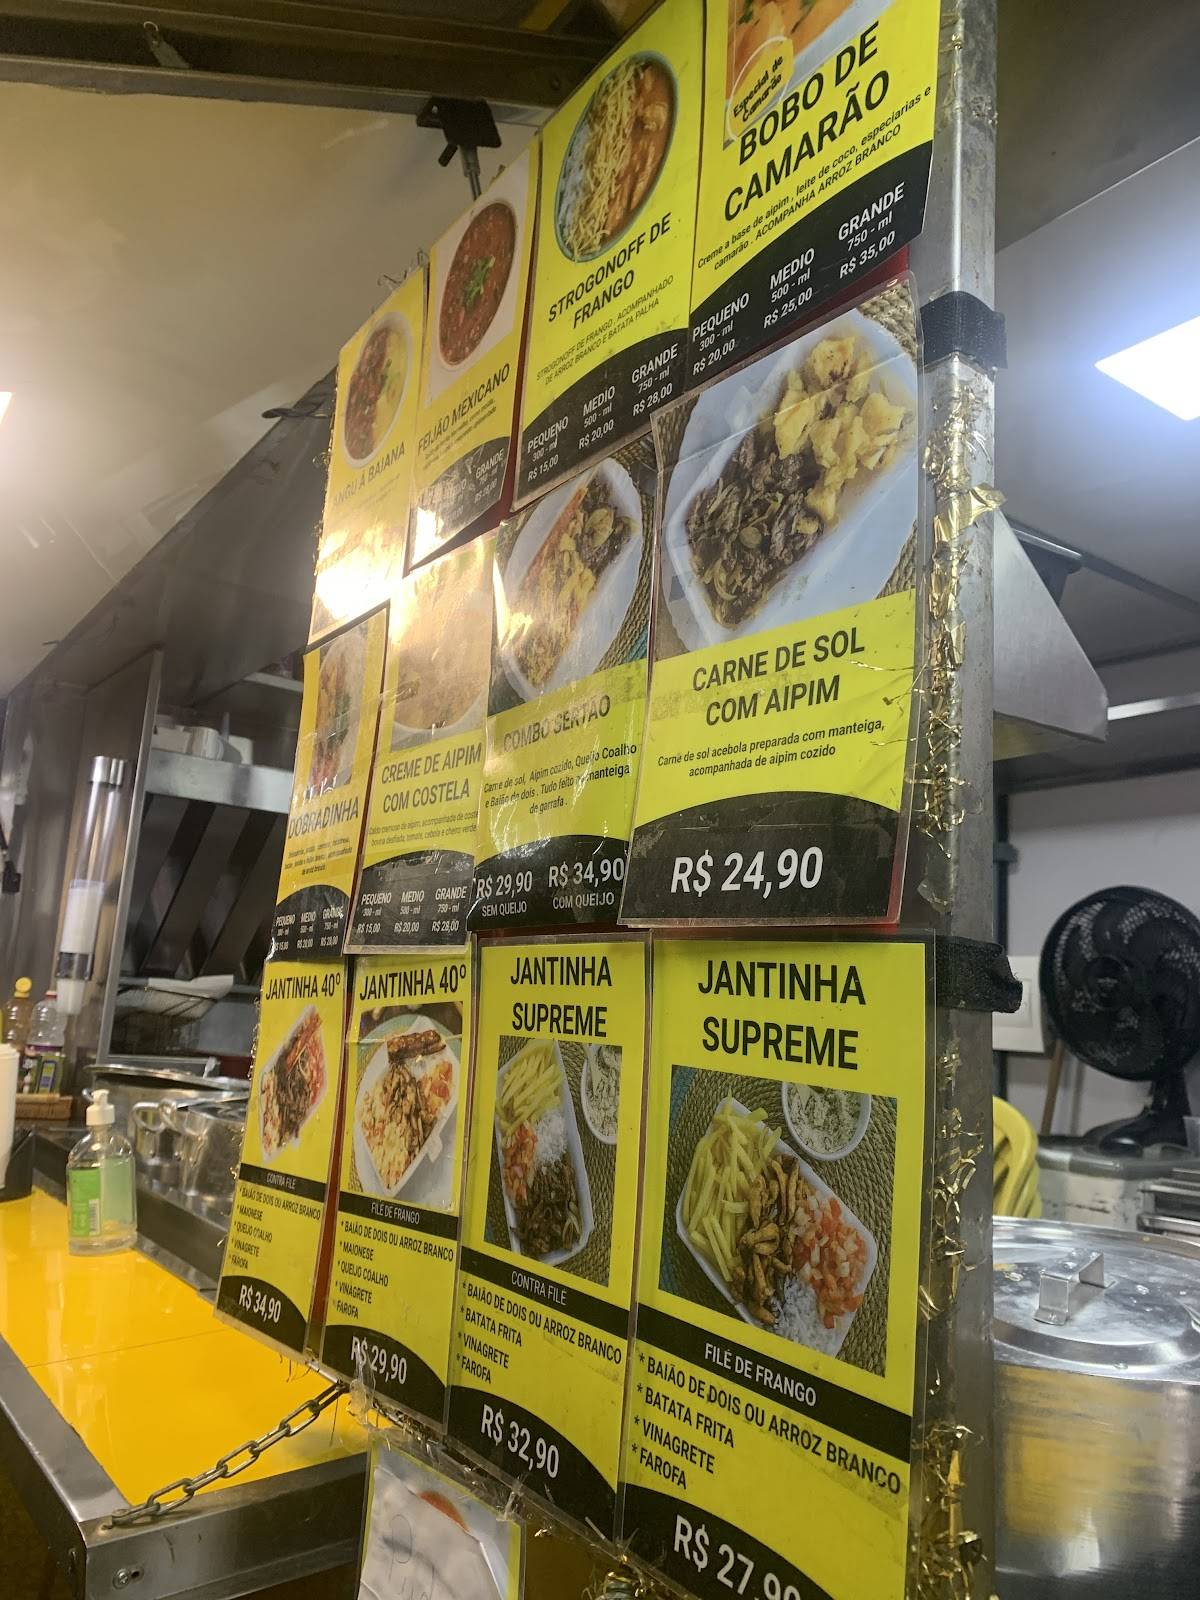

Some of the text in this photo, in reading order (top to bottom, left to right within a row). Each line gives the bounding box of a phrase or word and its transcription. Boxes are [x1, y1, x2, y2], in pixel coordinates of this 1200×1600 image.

[739, 21, 879, 165] BOBO DE
[724, 70, 889, 221] CAMARÃO
[698, 243, 723, 268] Creme
[732, 224, 751, 243] base
[753, 215, 763, 227] de
[797, 177, 815, 196] leite
[818, 165, 830, 179] de
[832, 147, 858, 168] coco,
[861, 96, 920, 146] especiarias
[924, 86, 931, 97] e
[714, 124, 900, 270] camarão ACOMPANHA ARROZ BRANCO
[838, 182, 905, 241] GRANDE
[848, 211, 892, 252] 750 ml
[549, 213, 671, 322] STROGONOFF DE
[770, 248, 815, 290] MEDIO
[840, 231, 895, 279] R$ 35,00
[574, 270, 634, 328] FRANGO
[692, 292, 749, 342] PEQUENO
[764, 287, 813, 329] R$ 25,00
[631, 343, 678, 383] GRANDE
[693, 339, 735, 375] R$ 20,00
[417, 415, 449, 456] FEIJÃO
[451, 363, 509, 426] MEXICANO
[583, 386, 615, 416] MEDIO
[633, 383, 673, 416] R$ 28,00
[527, 416, 568, 453] PEQUENO
[579, 419, 614, 449] R$ 20,00
[367, 442, 405, 482] BAIANA
[692, 627, 865, 692] CARNE DE SOL
[706, 674, 840, 726] COM AIPIM
[504, 723, 549, 752] COMBO
[658, 718, 885, 767] Carne de sol acebola preparada com manteiga,
[381, 742, 482, 784] CREME DE AIPIM
[530, 769, 548, 781] Aipim
[602, 744, 637, 759] Coalho
[689, 744, 836, 777] acompanhada de aipim cozido
[383, 778, 470, 813] COM COSTELA
[541, 781, 557, 794] Tudo
[288, 797, 359, 839] DOBRADINHA
[477, 870, 533, 899] R$ 29,90
[549, 857, 624, 888] R$ 34,90
[670, 846, 824, 899] R$ 24,90
[361, 892, 392, 905] PEQUENO
[401, 890, 424, 902] MEDIO
[435, 886, 467, 900] GRANDE
[482, 900, 527, 917] SEM QUEIJO
[553, 892, 614, 910] COM QUEIJO
[432, 921, 440, 932] R$
[266, 975, 318, 1000] JANTINHA
[360, 968, 435, 1000] JANTINHA
[511, 956, 612, 986] JANTINHA
[698, 960, 866, 1005] JANTINHA
[512, 1002, 607, 1037] SUPREME
[702, 1016, 858, 1070] SUPREME
[385, 1206, 393, 1217] DE
[394, 1208, 420, 1225] FRANGO
[343, 1241, 374, 1261] MAIONESE
[364, 1226, 372, 1238] DE
[372, 1228, 388, 1243] DOIS
[389, 1234, 398, 1246] OU
[399, 1236, 422, 1253] ARROZ
[424, 1242, 453, 1262] BRANCO
[341, 1260, 389, 1287] QUEIJO COALHO
[511, 1271, 545, 1296] CONTRA
[239, 1285, 281, 1323] R$ 34,90
[336, 1301, 359, 1319] FAROFA
[339, 1282, 372, 1304] VINAGRETE
[466, 1309, 522, 1347] BATATA FRITA
[468, 1281, 622, 1364] BAIÃO DE DOIS OU ARROZ BRANCO
[351, 1336, 407, 1384] R$ 29,90
[464, 1332, 510, 1369] VINAGRETE
[461, 1356, 491, 1384] FAROFA
[704, 1342, 816, 1407] FILÉ DE FRANGO
[645, 1386, 734, 1448] BATATA FRITA
[648, 1356, 901, 1494] BAIÃO DE DOIS OU ARROZ BRANCO
[481, 1404, 559, 1479] R$ 32,90
[643, 1421, 714, 1474] VINAGRETE
[639, 1447, 686, 1490] FAROFA
[674, 1514, 710, 1572] R$
